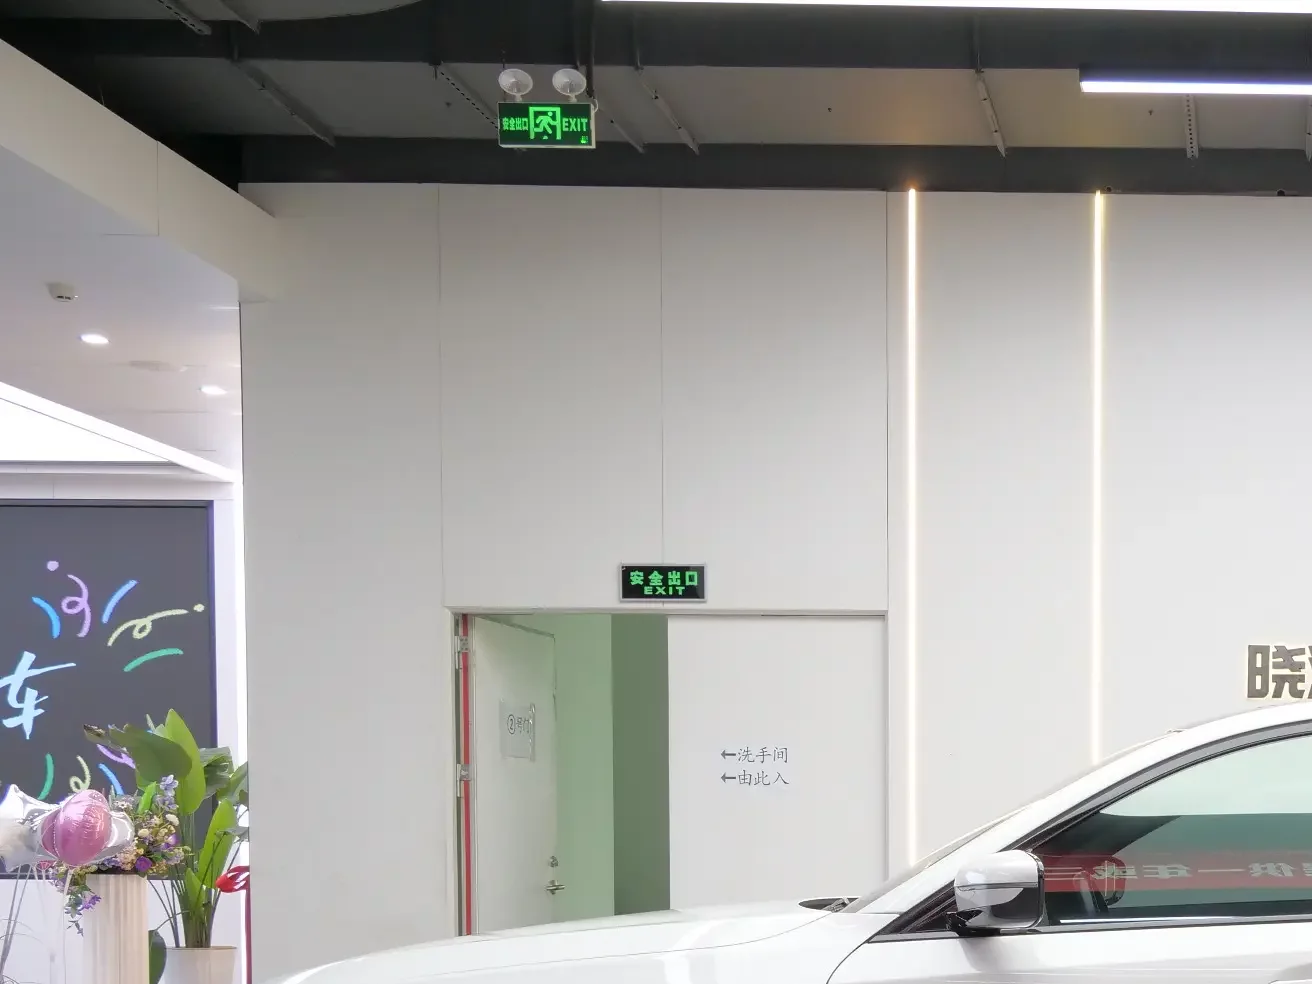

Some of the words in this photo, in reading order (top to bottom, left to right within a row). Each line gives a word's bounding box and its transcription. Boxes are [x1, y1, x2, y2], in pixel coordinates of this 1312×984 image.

[503, 117, 528, 131] 安全出口
[561, 118, 588, 132] EXIT
[630, 570, 699, 586] 安全出口
[644, 586, 685, 595] EXIT
[737, 747, 788, 764] 洗手间
[737, 770, 790, 786] 由此入
